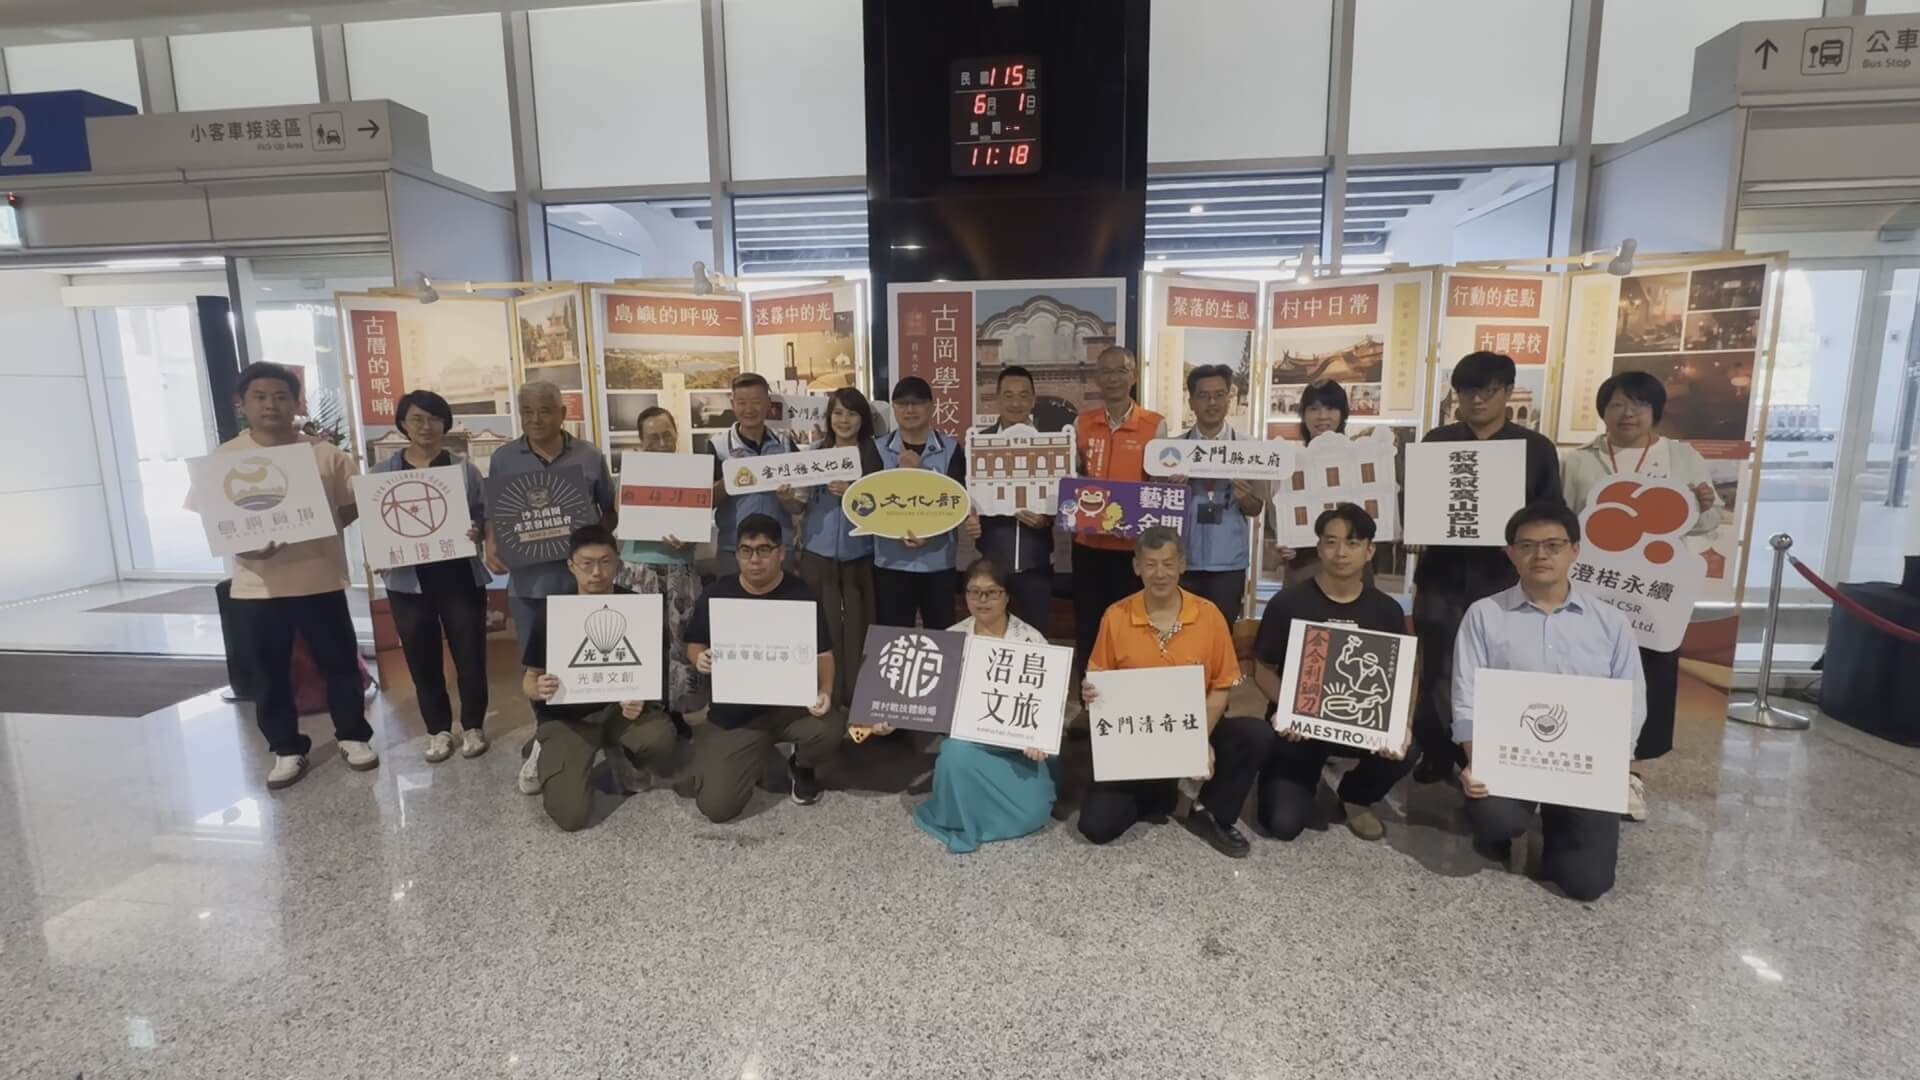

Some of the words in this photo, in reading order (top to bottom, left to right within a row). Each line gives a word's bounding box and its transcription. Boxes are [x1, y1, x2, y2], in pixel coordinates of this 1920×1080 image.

[1866, 28, 1920, 53] 公車
[1862, 59, 1881, 69] Bus
[1886, 58, 1911, 69] Stop
[0, 105, 33, 166] 2
[189, 118, 302, 143] 小客車接送區
[972, 145, 1029, 165] 11:18
[1173, 296, 1250, 320] 聚落的生息
[1280, 294, 1369, 320] 村中日常
[1452, 285, 1536, 308] 行動的起點
[755, 302, 831, 327] 迷霧中的光
[363, 316, 394, 416] 古厝的呢喃
[931, 304, 960, 437] 古岡學校
[1187, 445, 1280, 467] 金門縣政府
[880, 493, 961, 509] 文化部
[1140, 486, 1185, 510] 藝起
[1617, 600, 1642, 614] CSR
[1632, 619, 1655, 633] Ltd.
[986, 647, 1047, 689] 浯島
[977, 688, 1042, 729] 文旅
[1096, 713, 1199, 736] 金門清音社
